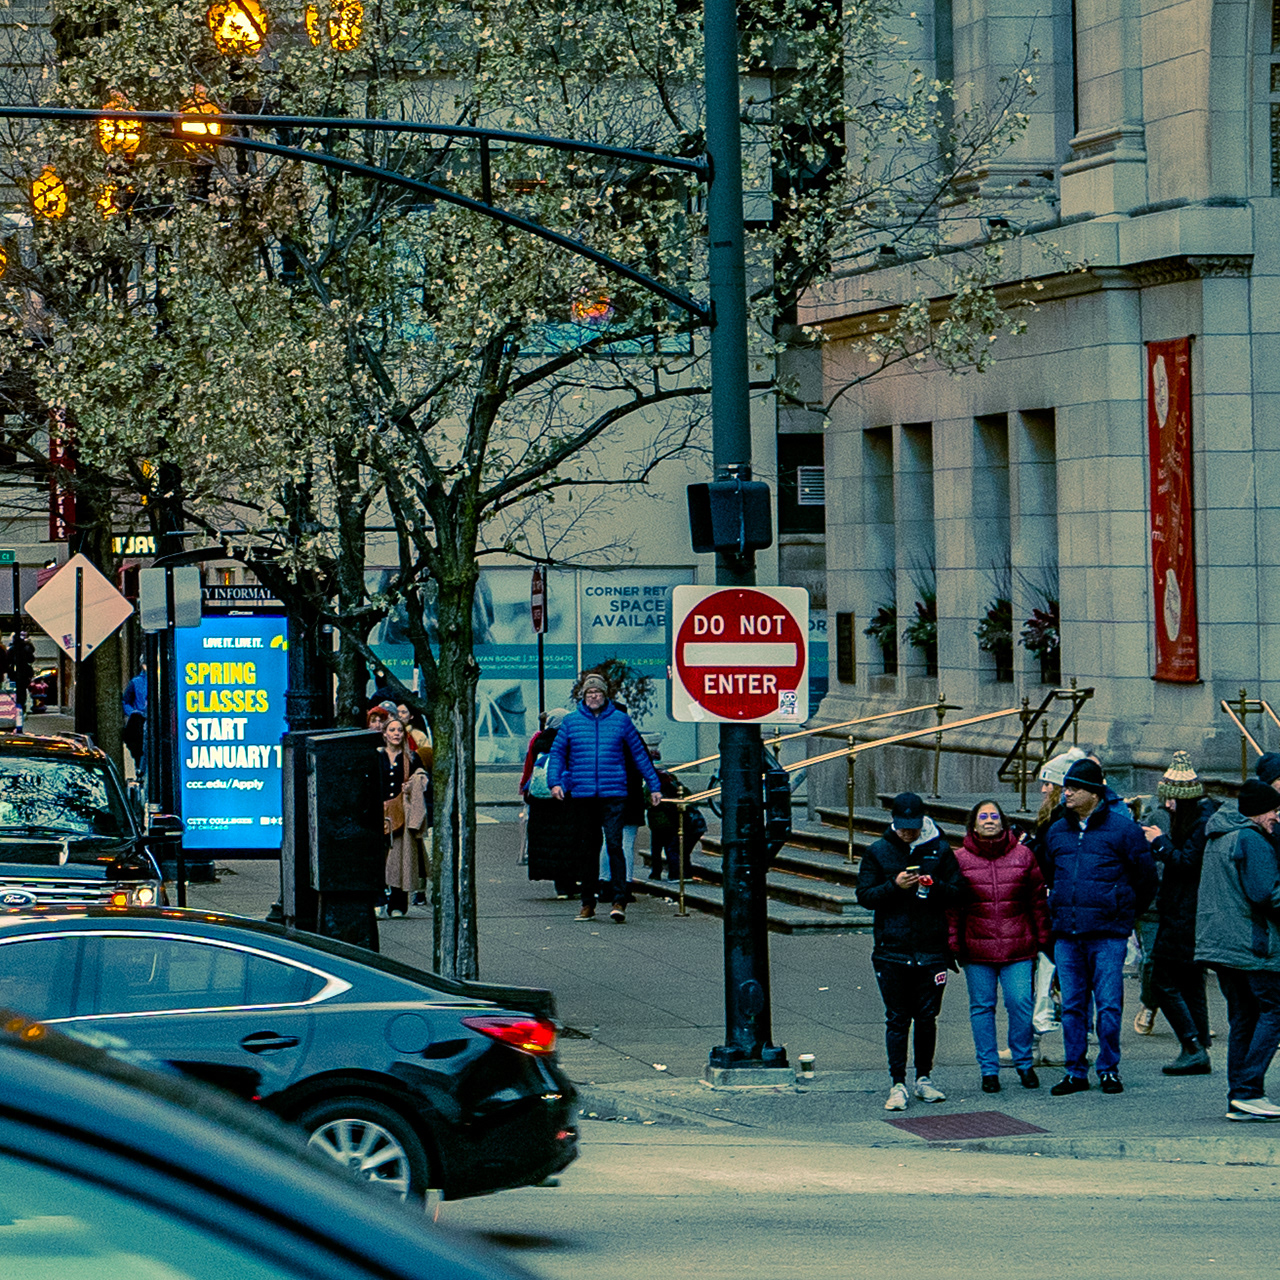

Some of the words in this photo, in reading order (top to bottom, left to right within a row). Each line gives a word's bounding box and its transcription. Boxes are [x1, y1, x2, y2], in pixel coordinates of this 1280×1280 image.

[585, 586, 640, 597] CORNER
[643, 586, 668, 597] RET
[610, 599, 665, 612] SPACE
[592, 615, 666, 628] AVAILAB
[694, 614, 725, 635] DO
[740, 614, 786, 635] NOT
[185, 662, 257, 685] SPRING
[704, 674, 778, 695] ENTER
[185, 689, 269, 713] CLASSES
[185, 718, 248, 741] START
[186, 745, 271, 769] JANUARY
[186, 778, 264, 790] ccc.edu/Apply
[4, 893, 27, 905] Ford
